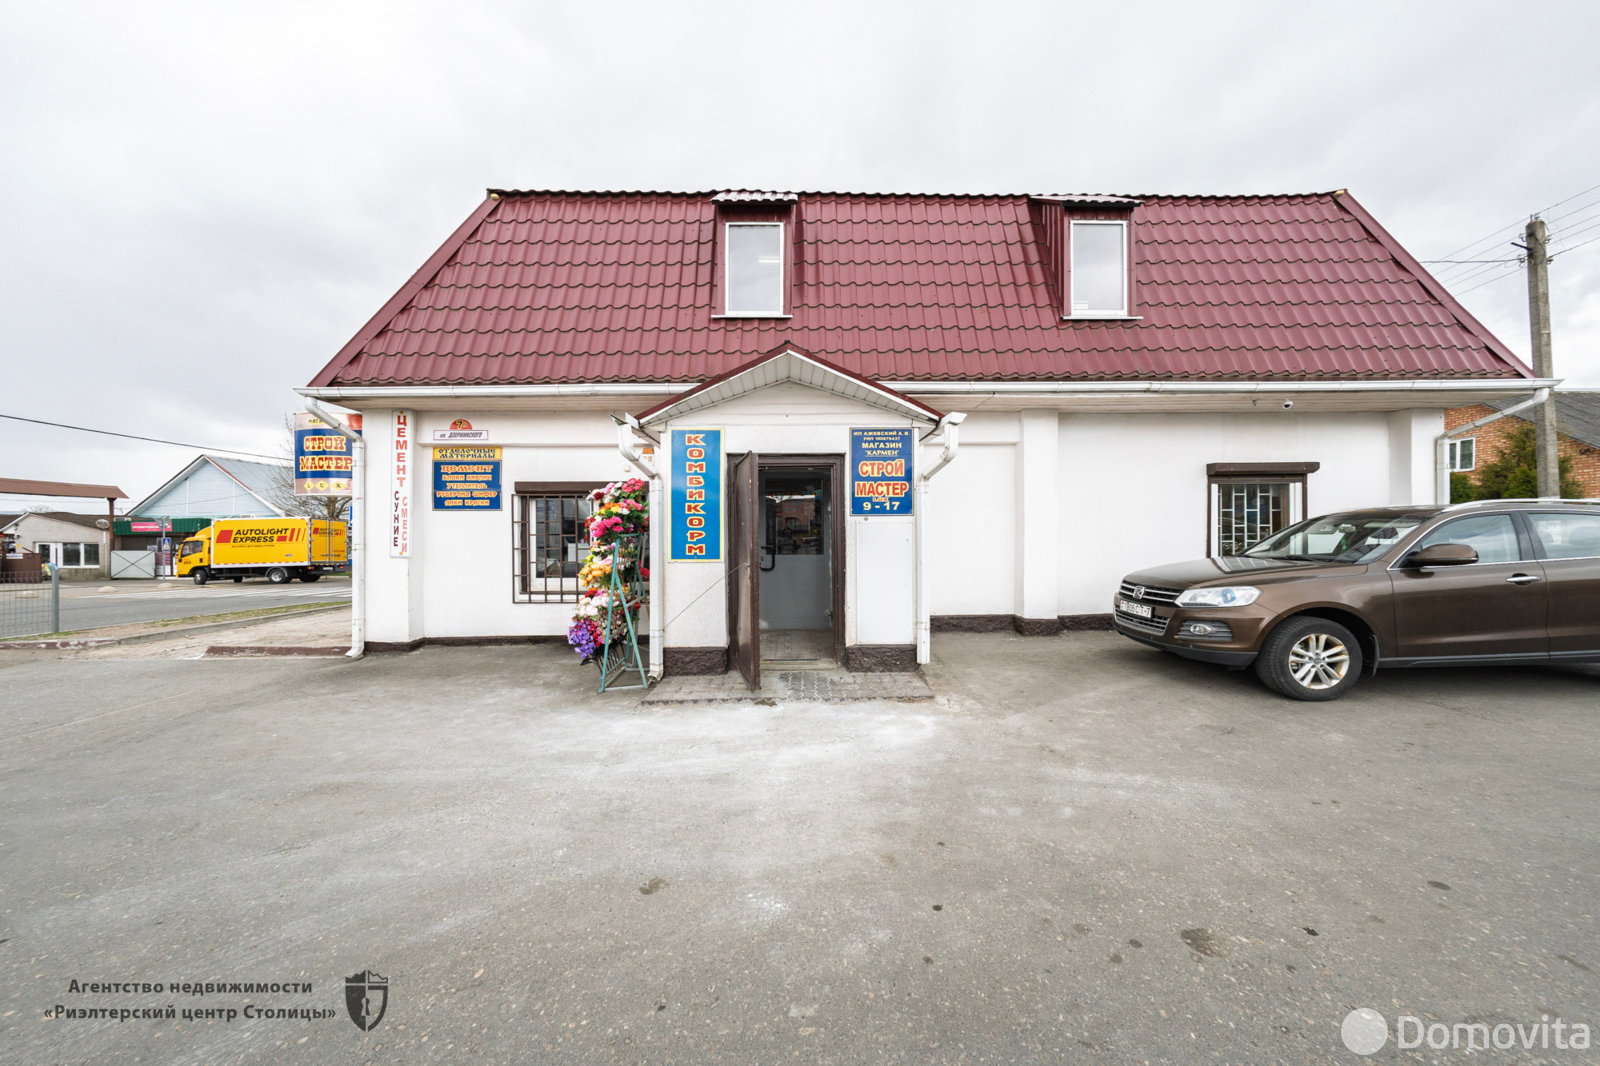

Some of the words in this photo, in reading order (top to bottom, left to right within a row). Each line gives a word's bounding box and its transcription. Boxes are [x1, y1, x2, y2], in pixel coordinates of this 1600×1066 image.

[303, 436, 346, 451] СТРОЙ
[395, 415, 407, 487] ЦЕМЕНТ
[300, 456, 352, 471] МАСТЕР
[441, 465, 493, 473] ЦЕМЕНТ
[858, 459, 905, 477] СТРОЙ
[685, 434, 706, 555] КОМБИКОРМ
[855, 481, 909, 497] МАСТЕР
[234, 528, 289, 536] AUTOLIGHT
